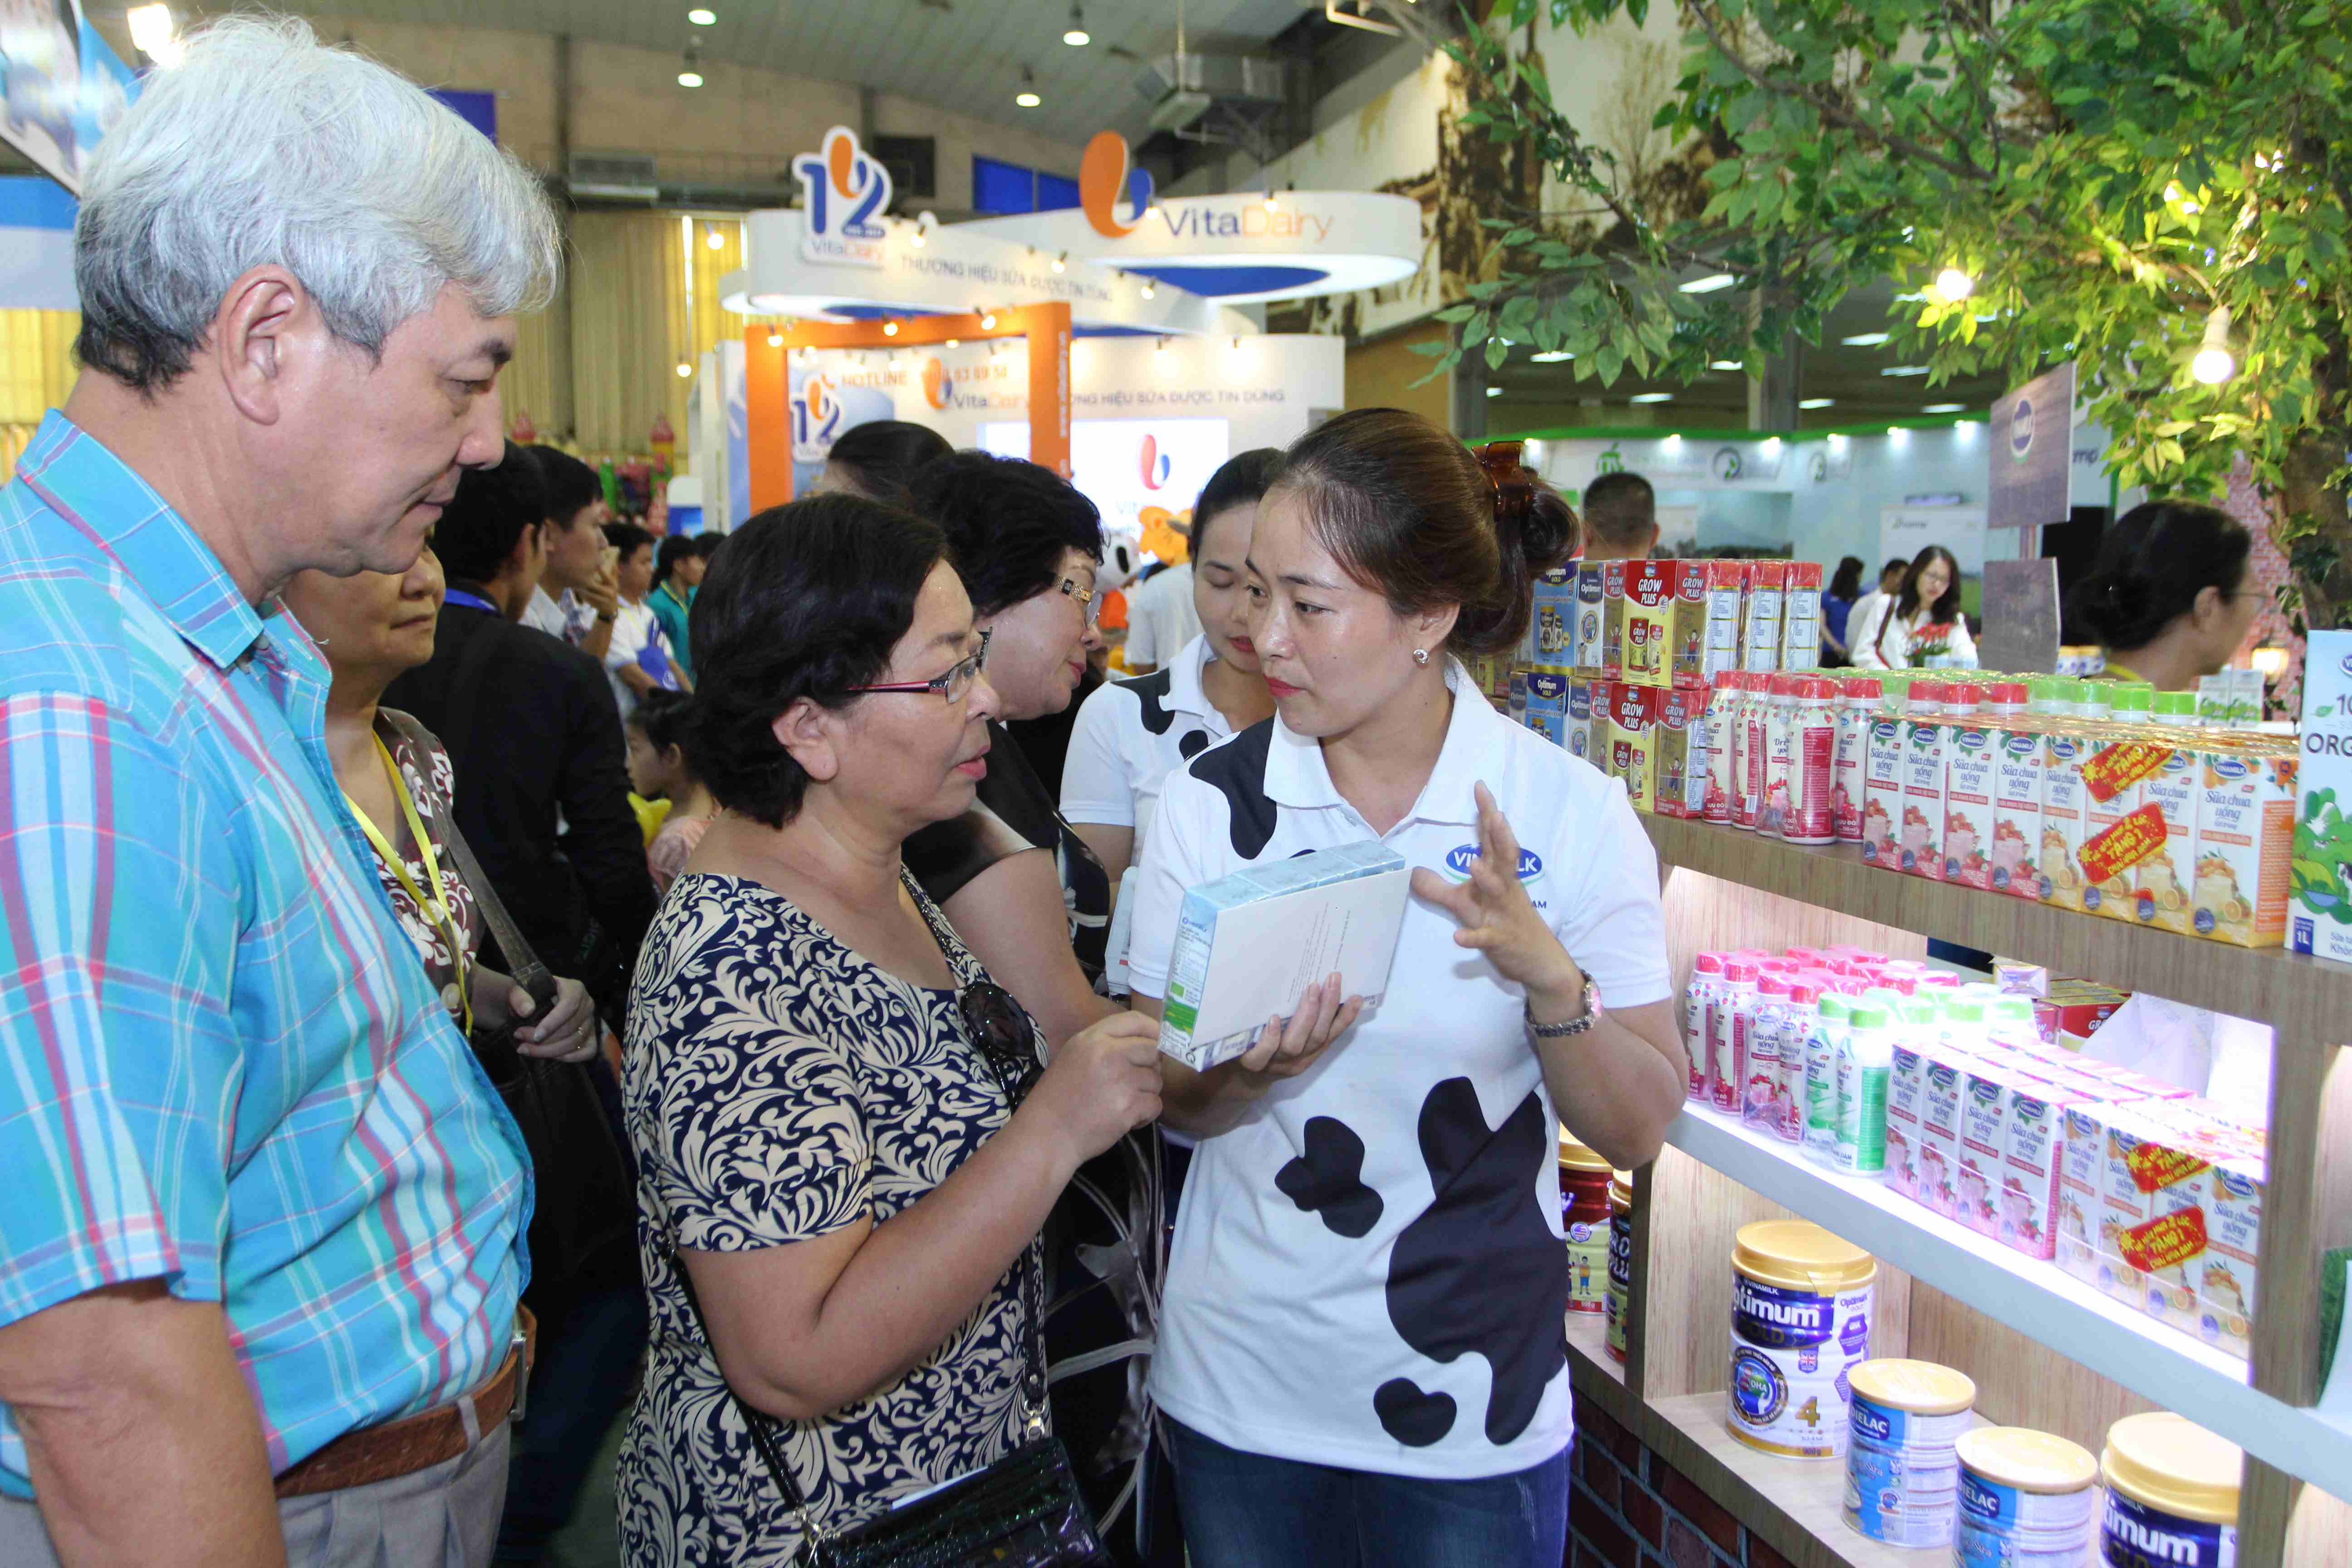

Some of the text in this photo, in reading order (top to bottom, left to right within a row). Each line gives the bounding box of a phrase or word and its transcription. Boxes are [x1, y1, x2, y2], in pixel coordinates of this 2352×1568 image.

[1163, 206, 1333, 242] VitaDairy
[1607, 577, 1623, 586] GROW
[1638, 578, 1662, 592] GROW
[1682, 578, 1704, 588] GROW
[1641, 593, 1656, 604] PLUS
[1686, 588, 1700, 598] PLUS
[1538, 679, 1557, 691] Optimum
[1594, 696, 1610, 706] GROW
[1596, 706, 1607, 715] PLUS
[1622, 703, 1644, 717] GROW
[1666, 705, 1685, 716] GROW
[1624, 717, 1639, 729] PLUS
[1668, 716, 1682, 726] PLUS
[2010, 741, 2033, 749] VINAMILK
[2306, 732, 2352, 757] ORG
[1617, 750, 1628, 760] GROW
[1884, 750, 1898, 761] chua
[1923, 756, 1938, 767] chua
[1971, 761, 1988, 772] chua
[2019, 767, 2037, 779] chua
[2062, 774, 2077, 785] chua
[2168, 786, 2188, 799] chua
[2228, 794, 2251, 807] chua
[1454, 851, 1537, 872] VILK
[2297, 930, 2309, 945] 1L
[2224, 1181, 2254, 1195] VINAMILK
[2234, 1211, 2257, 1228] chua
[1750, 1380, 1768, 1393] DHA
[1795, 1396, 1821, 1427] 4
[1851, 1406, 1887, 1433] DIELAC
